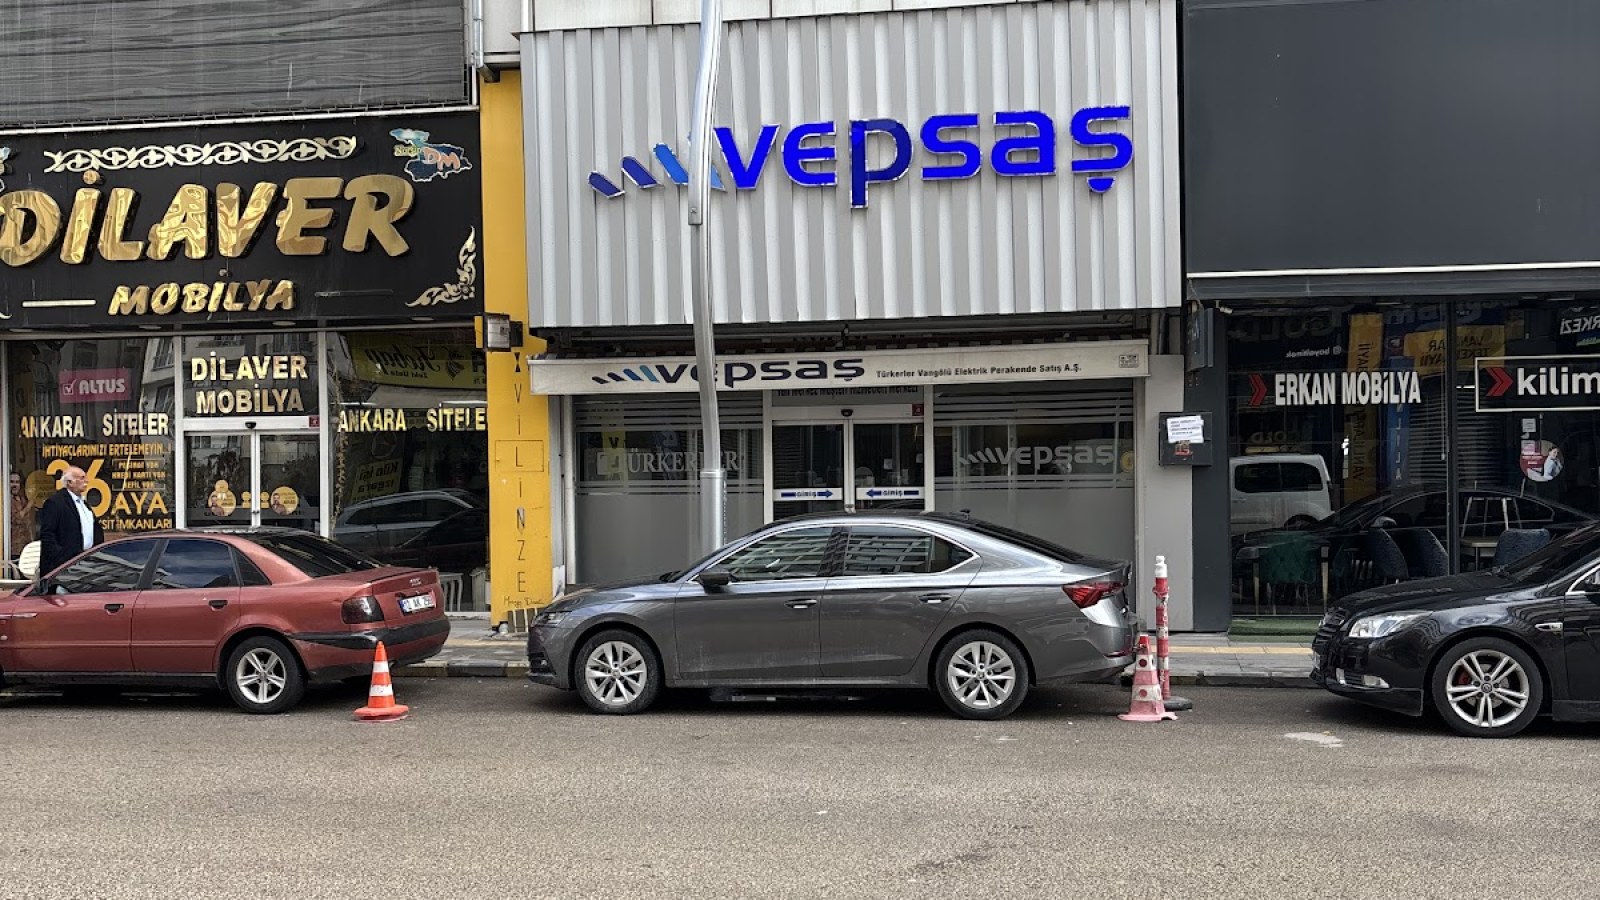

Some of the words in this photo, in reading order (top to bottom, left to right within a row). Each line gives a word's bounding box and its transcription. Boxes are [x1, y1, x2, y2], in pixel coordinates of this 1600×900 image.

[0, 171, 415, 267] DİLAVER
[107, 268, 296, 316] MOBİLYA
[191, 351, 308, 381] DİLAVER
[954, 365, 988, 376] Elektrik
[990, 362, 1037, 375] Perakende
[1517, 366, 1600, 396] kilim
[79, 377, 125, 394] ALTUS
[196, 383, 304, 414] MOBİLYA
[1275, 372, 1336, 406] ERKAN
[20, 414, 85, 439] ANKARA
[102, 409, 169, 437] SİTELER
[337, 407, 407, 433] ANKARA
[111, 491, 169, 515] AYA
